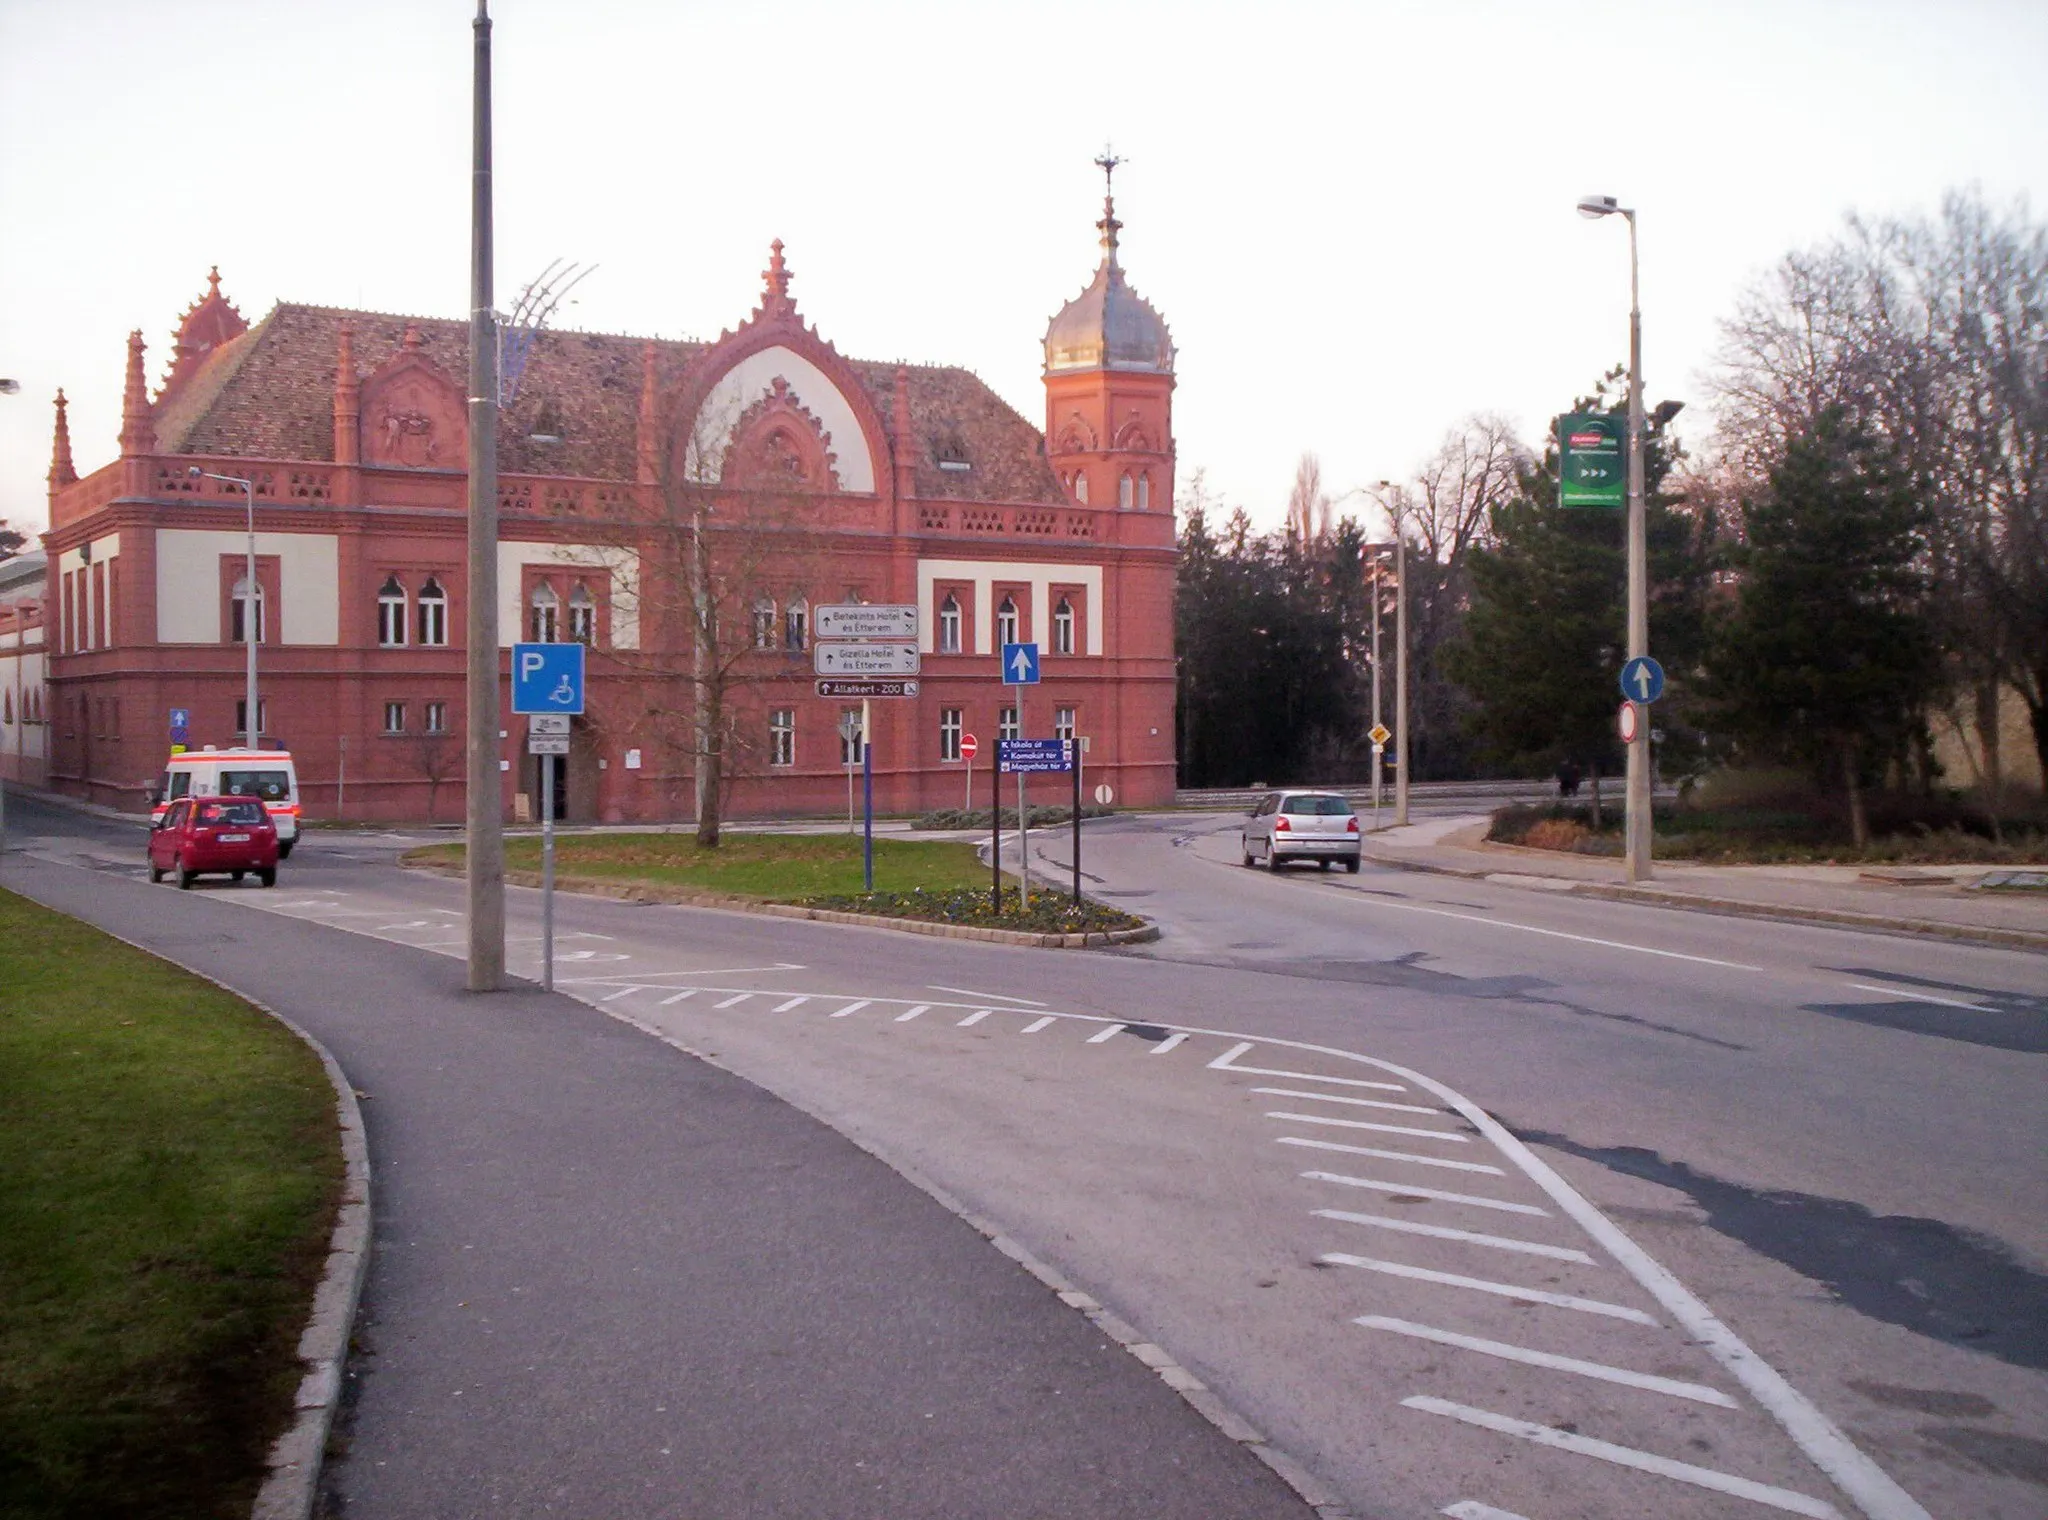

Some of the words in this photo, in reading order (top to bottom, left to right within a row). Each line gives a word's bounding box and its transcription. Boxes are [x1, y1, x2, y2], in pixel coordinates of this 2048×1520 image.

[877, 612, 900, 621] Hotel
[839, 649, 869, 658] Gizella
[871, 649, 895, 658] Hotel
[522, 652, 545, 682] P
[881, 684, 901, 694] ZOO
